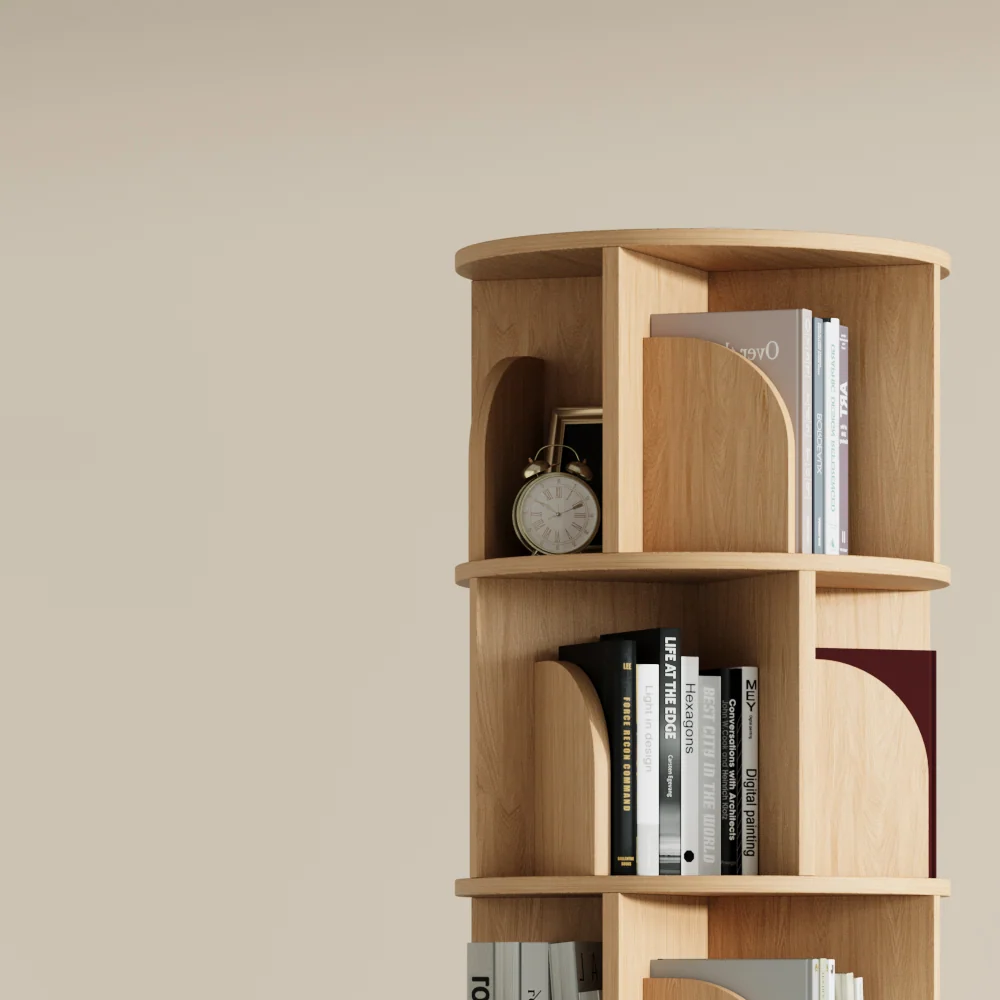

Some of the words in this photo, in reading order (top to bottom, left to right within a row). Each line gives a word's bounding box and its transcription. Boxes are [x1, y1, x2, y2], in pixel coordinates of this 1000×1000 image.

[664, 636, 677, 662] LIFE
[623, 662, 632, 670] LEE
[664, 664, 677, 679] AT
[644, 685, 654, 714] Light
[664, 681, 677, 704] THE
[702, 686, 716, 722] BEST
[746, 680, 757, 712] MEY
[622, 696, 631, 726] FORCE
[646, 718, 654, 730] in
[664, 707, 677, 740] EDGE
[682, 683, 696, 754] Hexagons
[622, 730, 631, 761] RECON
[702, 726, 716, 757] CITY
[728, 698, 737, 768] Conversations
[644, 732, 654, 772] design
[622, 764, 631, 812] COMMAND
[702, 782, 716, 809] THE
[728, 770, 737, 790] with
[744, 769, 757, 806] Digital
[728, 792, 737, 841] Architects
[702, 814, 716, 864] WORLD
[744, 810, 757, 857] painting
